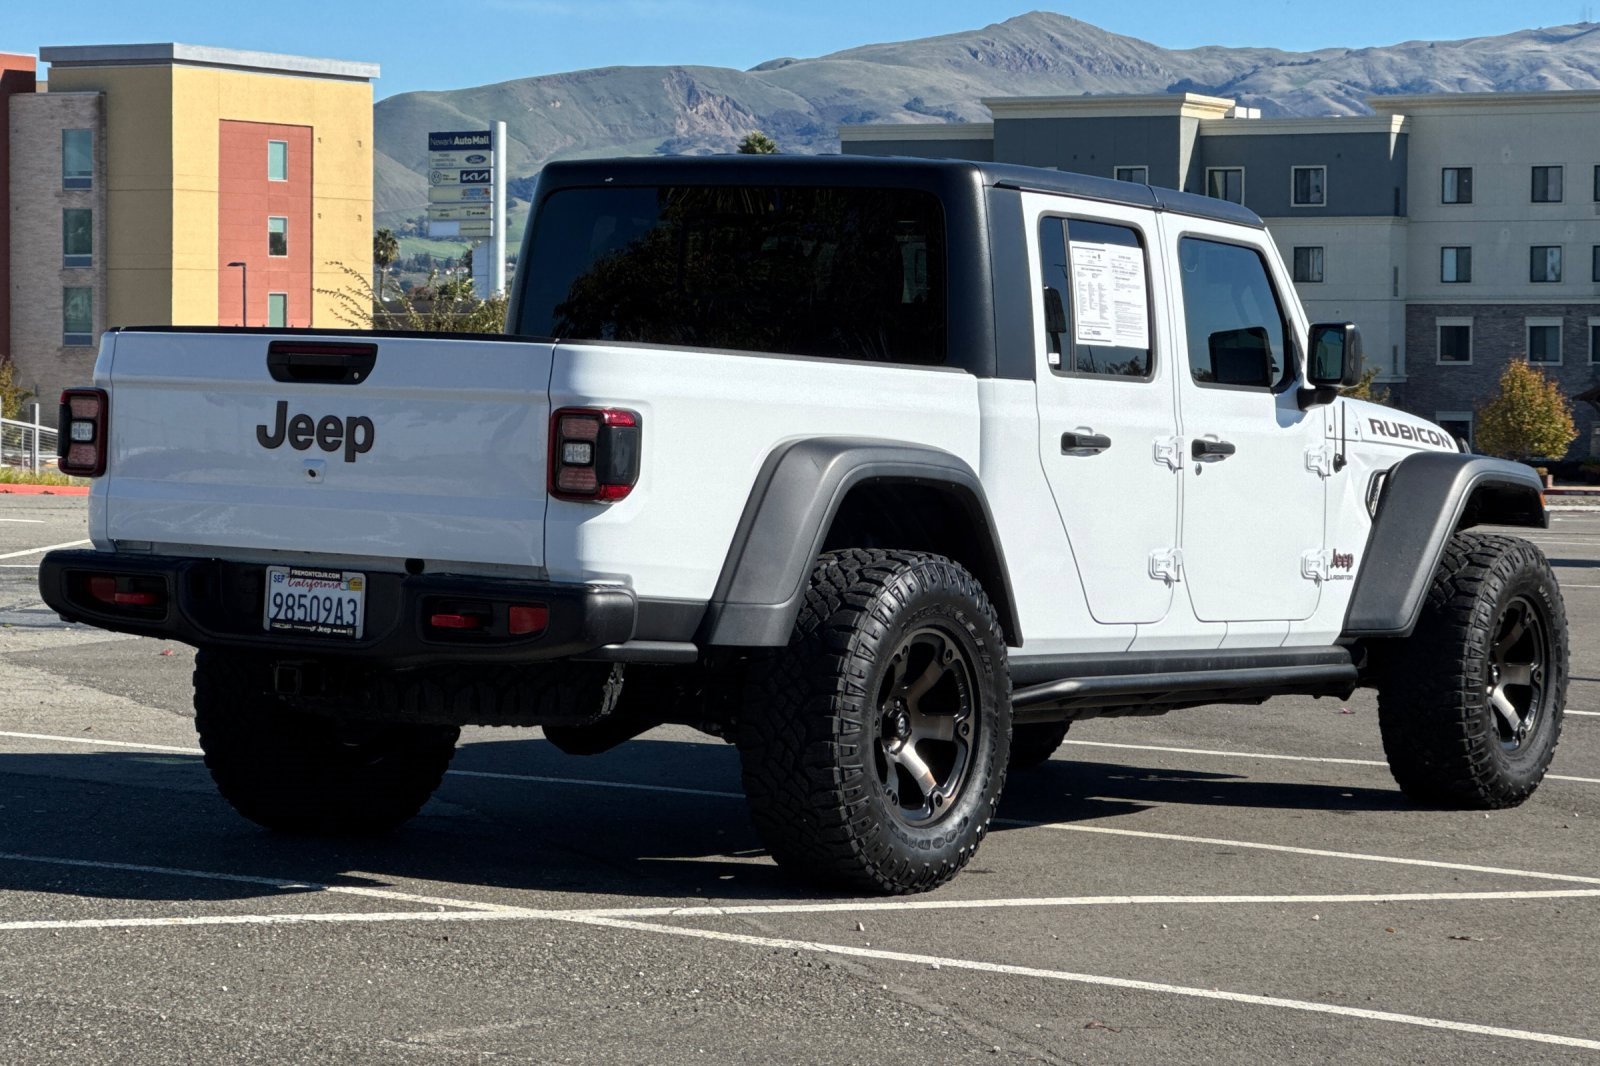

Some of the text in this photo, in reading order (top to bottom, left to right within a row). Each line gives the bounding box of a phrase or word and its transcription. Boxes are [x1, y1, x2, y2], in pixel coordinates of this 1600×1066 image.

[256, 400, 375, 463] Jeep
[1368, 418, 1453, 449] RUBICON
[1330, 548, 1354, 572] Jeep
[287, 576, 341, 592] California
[291, 569, 340, 578] FREMONTCDJR.COM
[273, 592, 357, 626] 98509A3
[317, 625, 331, 634] Jeep
